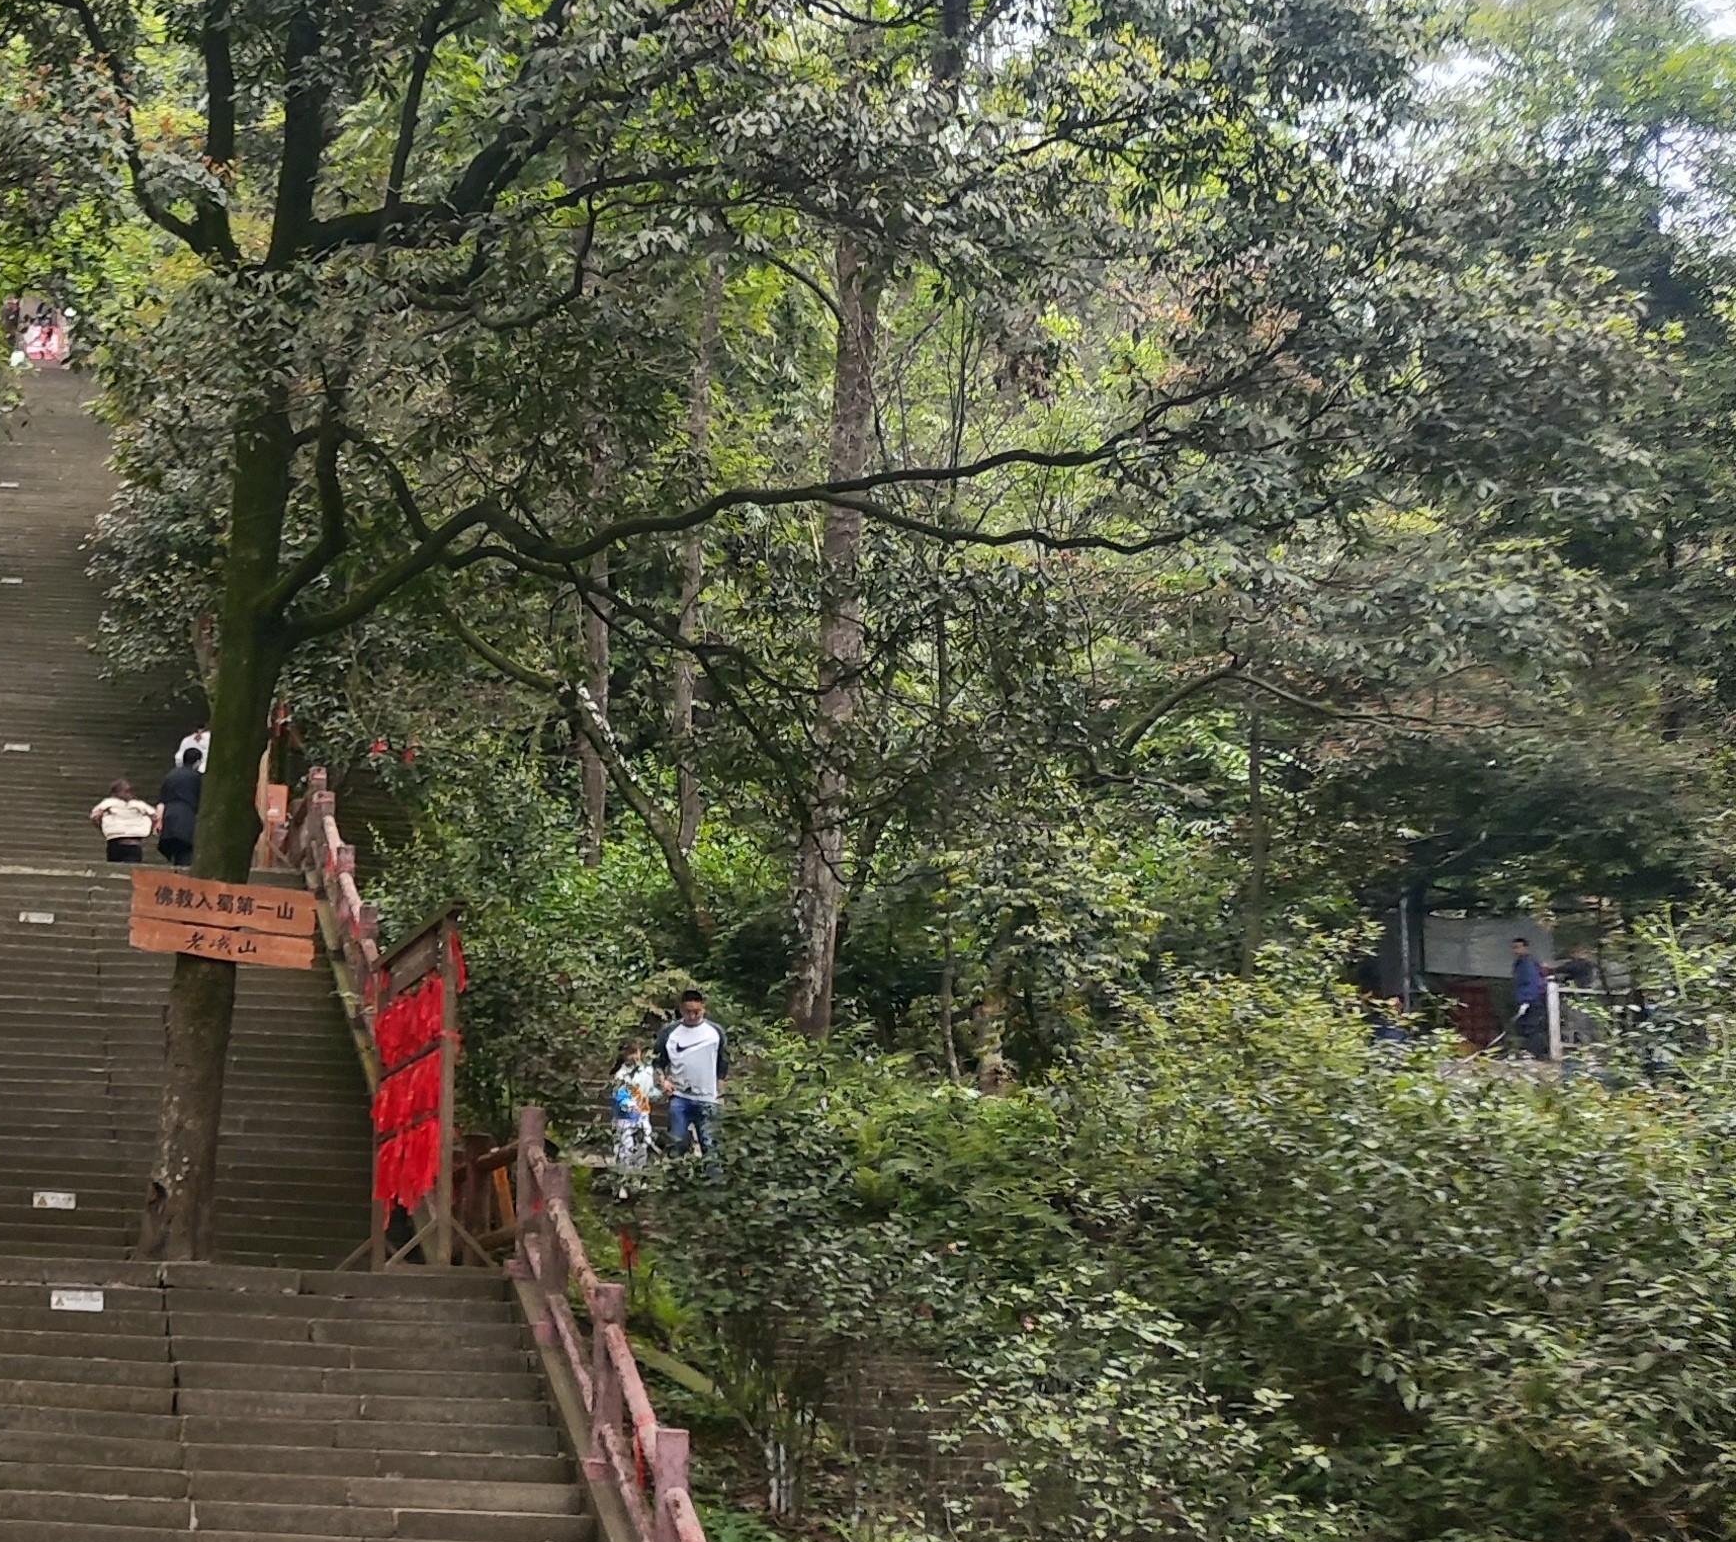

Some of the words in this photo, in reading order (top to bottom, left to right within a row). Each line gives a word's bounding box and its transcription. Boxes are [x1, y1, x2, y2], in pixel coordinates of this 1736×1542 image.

[154, 884, 295, 920] 佛教入蜀第一山
[185, 931, 258, 955] 老峨山
